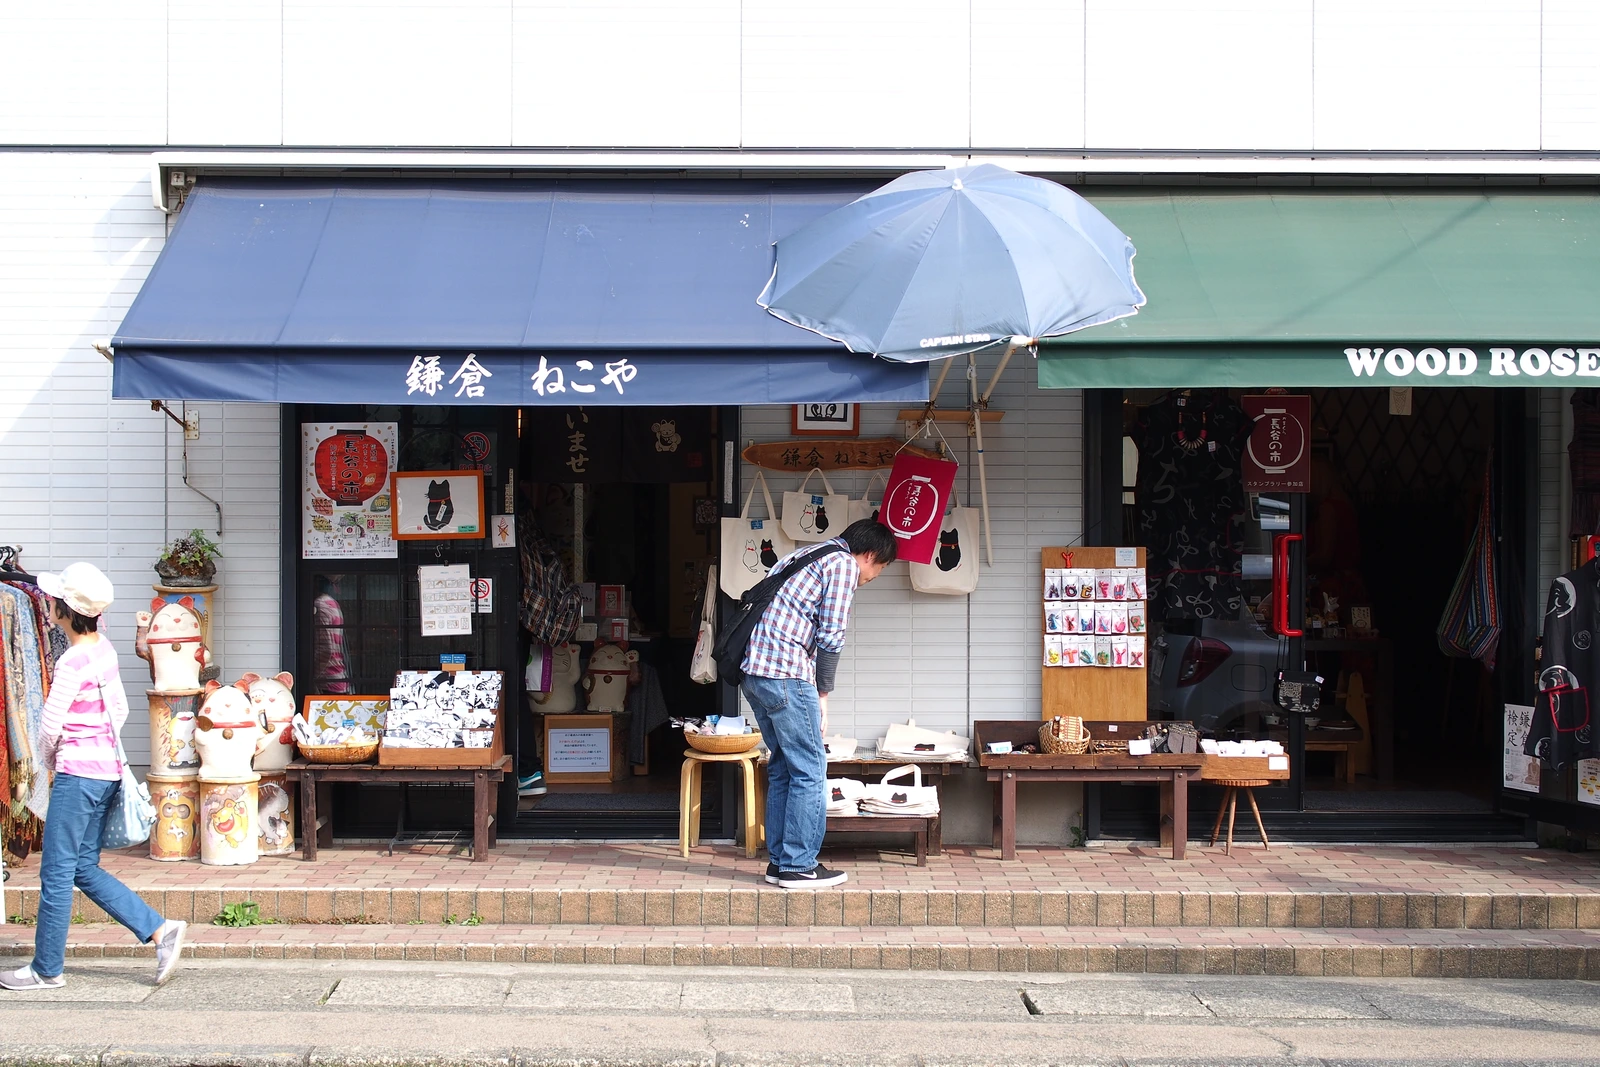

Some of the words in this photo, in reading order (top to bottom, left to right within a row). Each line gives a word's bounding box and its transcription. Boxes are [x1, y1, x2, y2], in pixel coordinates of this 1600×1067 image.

[920, 335, 964, 348] CAPTAIN
[965, 333, 991, 343] STAG
[405, 353, 493, 398] 鎌倉
[531, 355, 638, 397] ねこや
[1344, 347, 1478, 377] WOOD
[1489, 347, 1600, 377] ROSE
[566, 406, 589, 473] いませ
[780, 447, 824, 468] 鎌倉
[834, 449, 895, 466] ねこや
[1268, 418, 1283, 463] 長谷の市
[901, 484, 922, 527] 長谷の市
[1506, 709, 1519, 747] 検定
